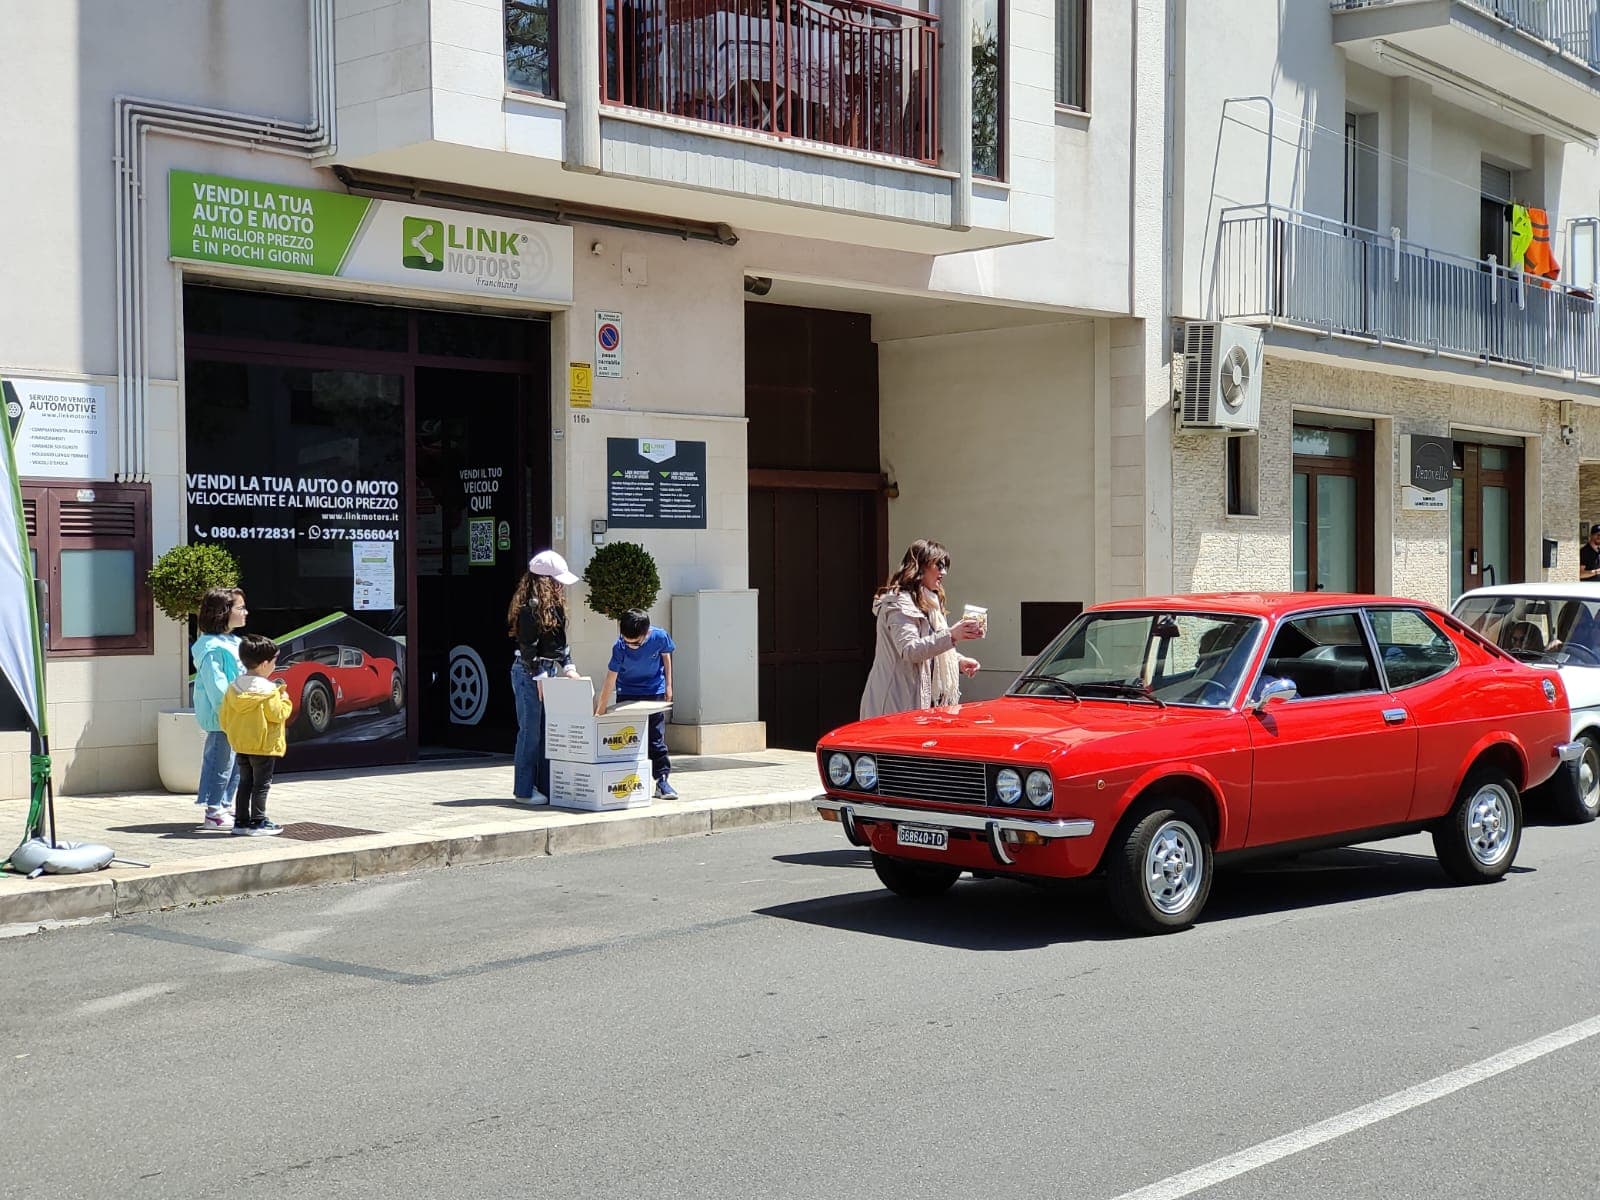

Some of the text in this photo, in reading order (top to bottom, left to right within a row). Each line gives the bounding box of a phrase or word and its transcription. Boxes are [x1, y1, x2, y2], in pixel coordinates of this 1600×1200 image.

[193, 183, 314, 215] VENDI LA TUA
[193, 204, 314, 234] AUTO E MOTO
[193, 224, 314, 251] AL MIGLIOR PREZZO
[193, 240, 314, 267] E IN POCHI GIORNI
[448, 251, 521, 280] MOTORS
[29, 394, 59, 402] SERVIZIO
[69, 396, 97, 404] VENDITA
[29, 401, 97, 414] AUTOMOTIVE
[42, 412, 97, 420] www.linkmotors.it
[460, 467, 503, 480] VENDI IL TUO
[186, 474, 398, 495] VENDI LA TUA AUTO O MOTO
[464, 480, 499, 493] VEICOLO
[187, 491, 398, 510] VELOCEMENTE E AL MIGLIOR PREZZO
[470, 495, 492, 512] QUI!
[321, 512, 399, 521] www.linkmotors.it
[211, 526, 295, 539] 080.8172831
[322, 528, 399, 541] 377.3566041
